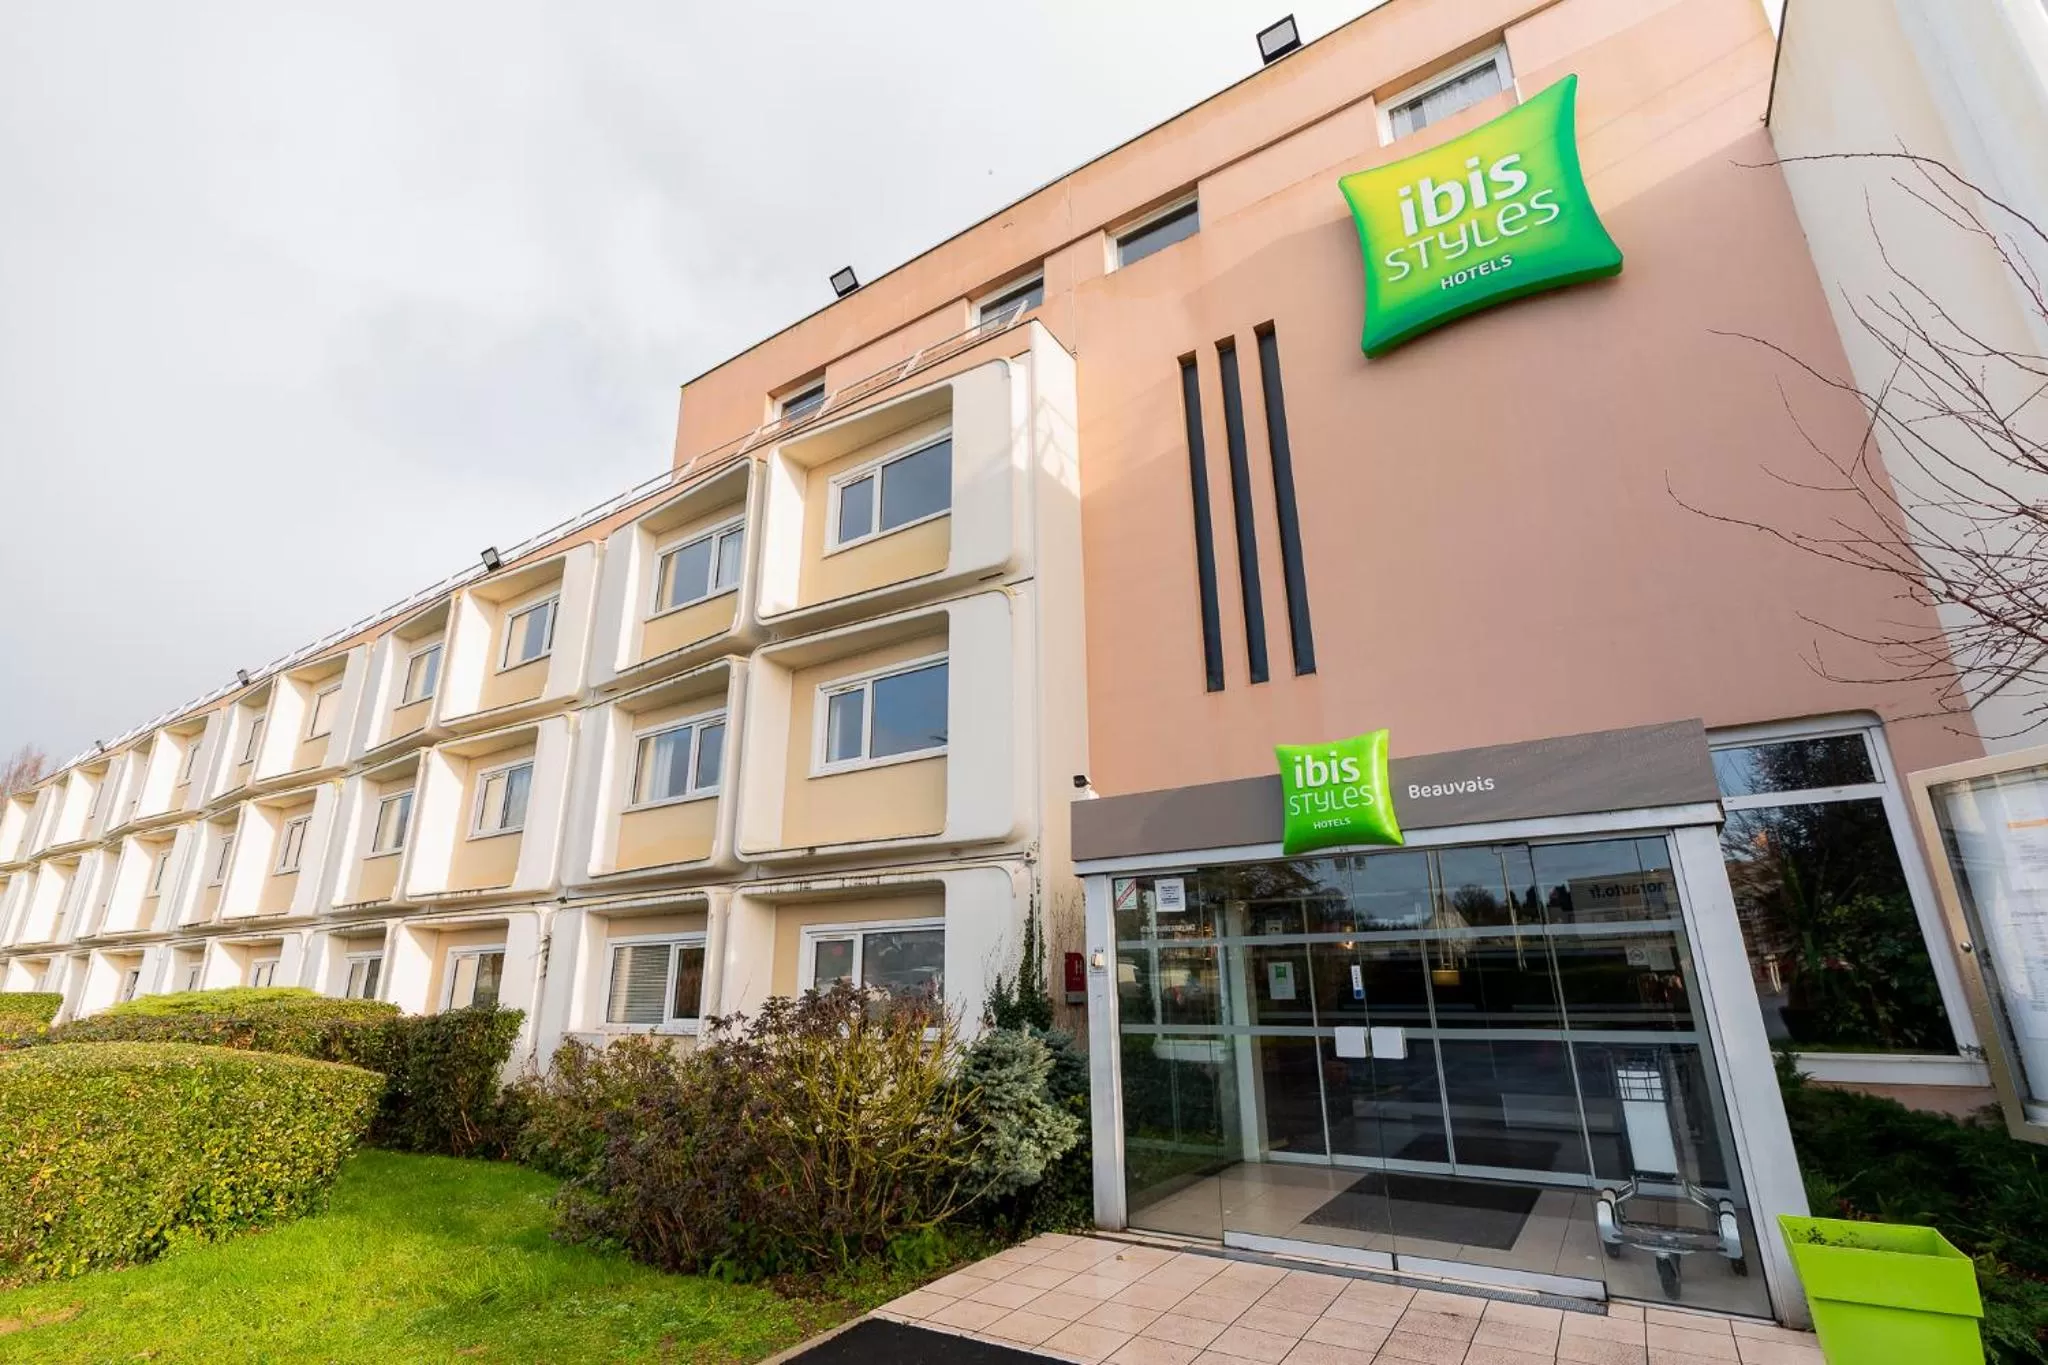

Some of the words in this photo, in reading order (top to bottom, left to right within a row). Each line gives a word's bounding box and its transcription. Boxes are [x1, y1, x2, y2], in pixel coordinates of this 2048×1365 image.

[1398, 153, 1527, 237] ibis
[1441, 255, 1512, 289] HOTELS
[1294, 751, 1360, 788] ibis
[1408, 776, 1495, 799] Beauvais
[1313, 817, 1351, 829] HOTELS
